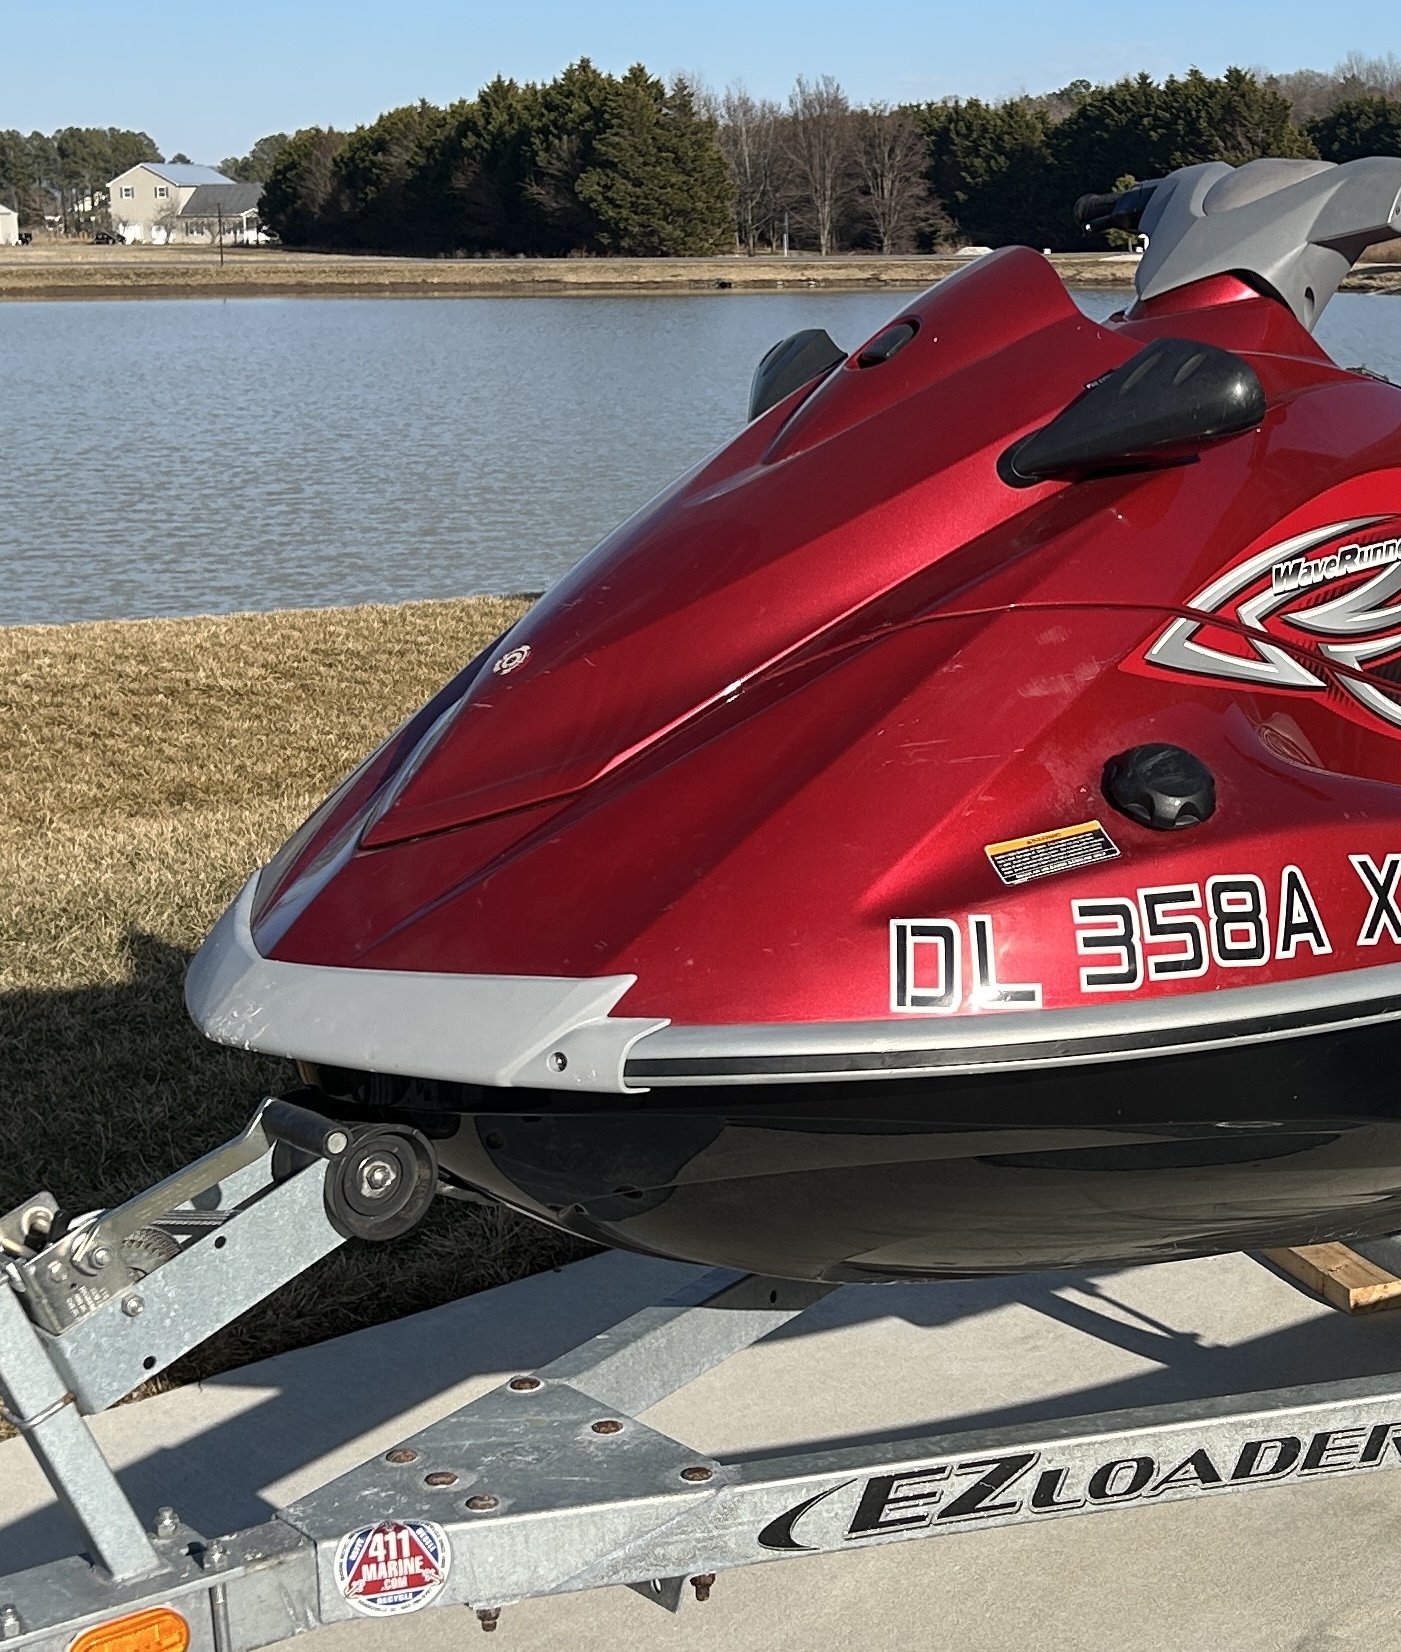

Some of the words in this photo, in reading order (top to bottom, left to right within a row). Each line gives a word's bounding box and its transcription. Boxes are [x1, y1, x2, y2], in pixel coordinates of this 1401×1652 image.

[890, 914, 1042, 1013] DL
[1072, 865, 1331, 992] 358A
[368, 1529, 411, 1562] 411
[361, 1555, 424, 1582] MARINE
[381, 1576, 408, 1591] .COM
